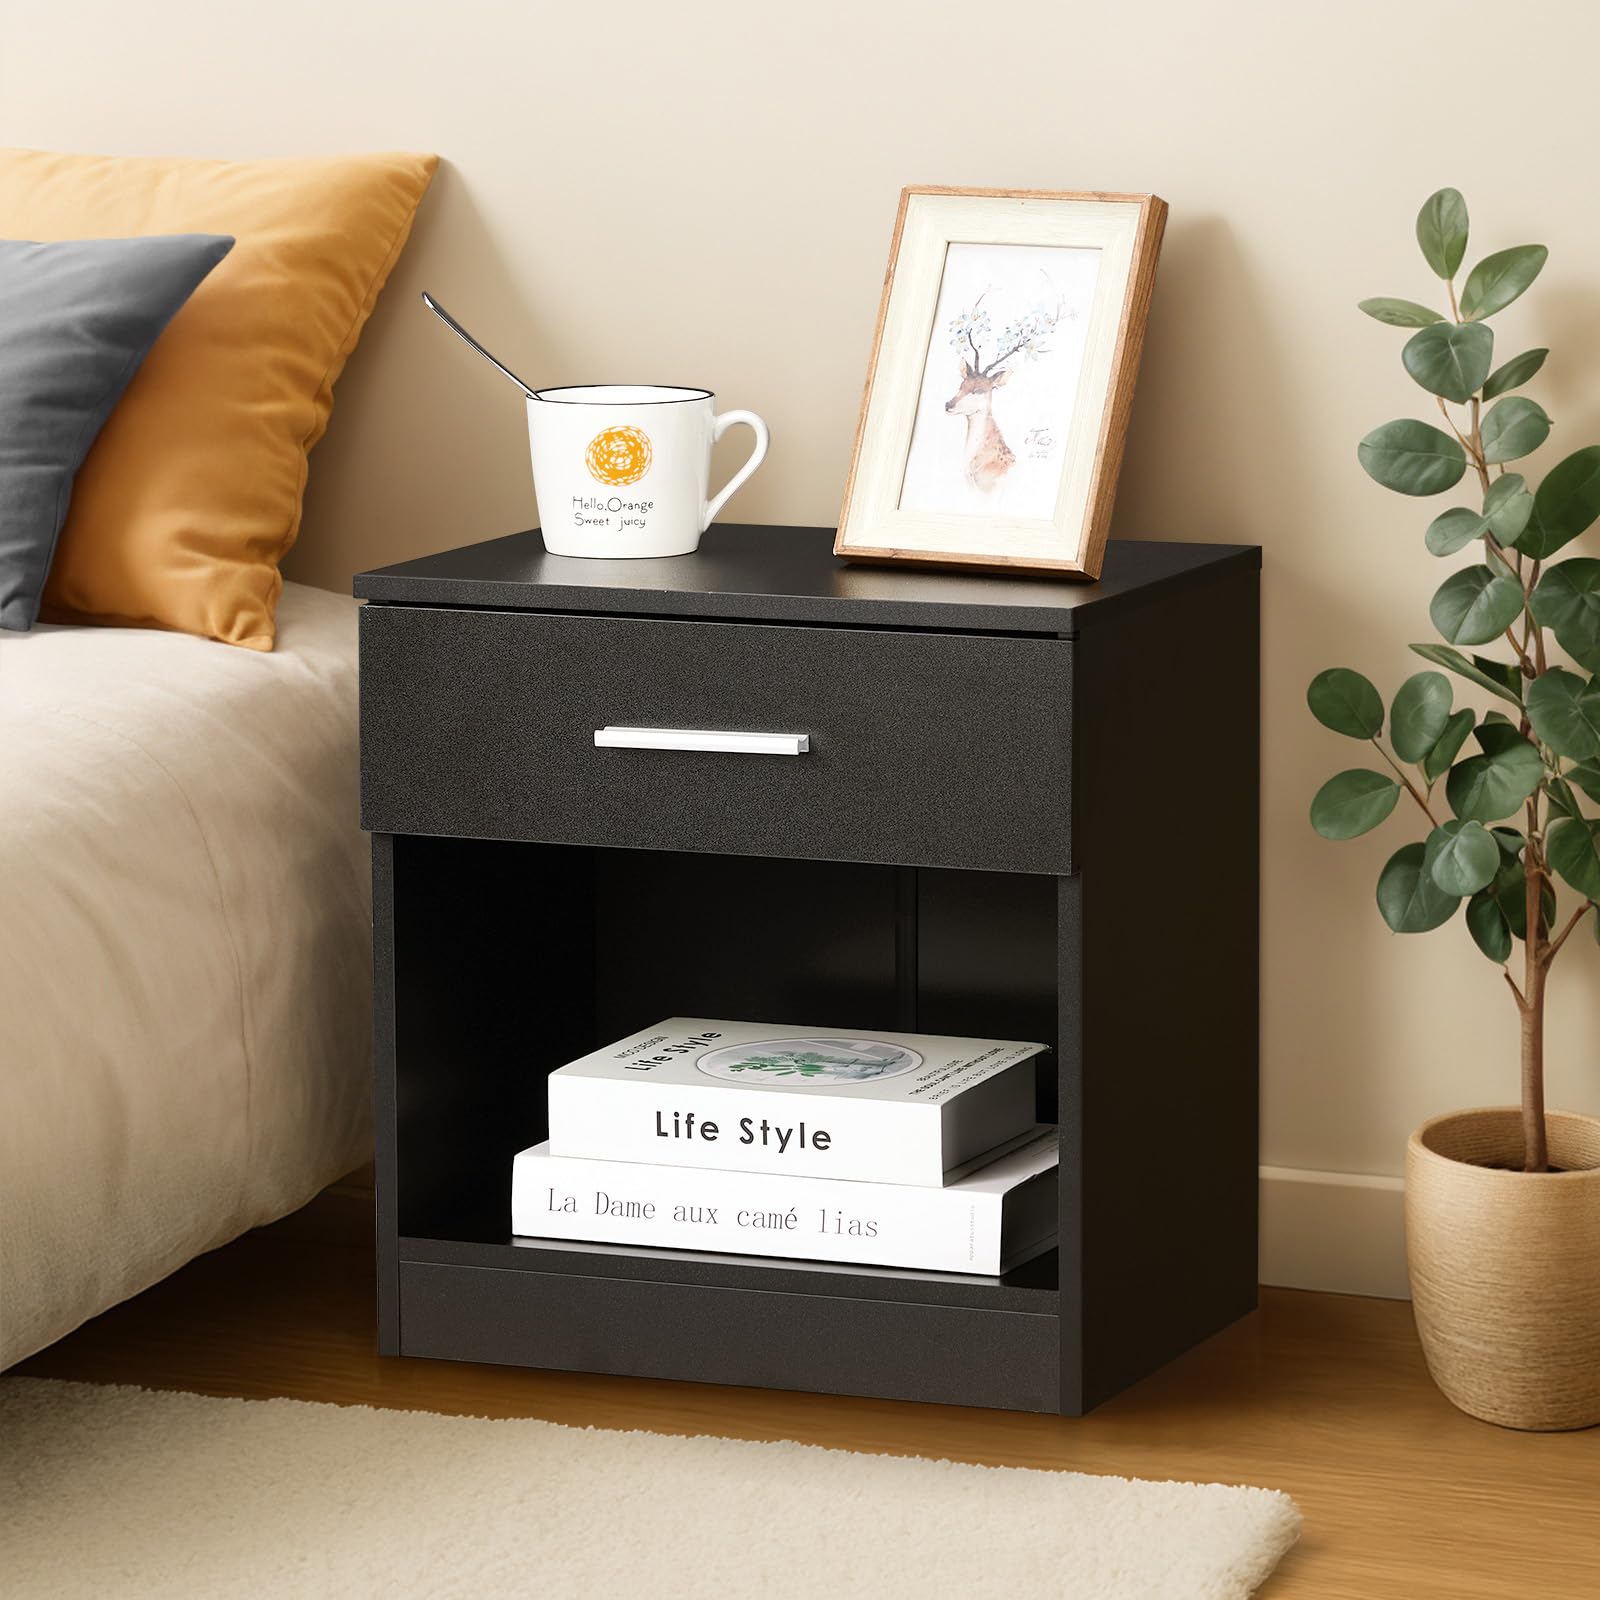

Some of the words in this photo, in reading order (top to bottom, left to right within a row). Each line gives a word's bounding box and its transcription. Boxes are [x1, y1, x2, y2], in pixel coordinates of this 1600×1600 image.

[574, 512, 610, 526] Sweet
[618, 516, 646, 531] juicy
[624, 1055, 673, 1071] Life
[662, 1032, 722, 1053] Style
[655, 1110, 720, 1142] Life
[738, 1117, 832, 1154] Style
[547, 1187, 578, 1213] La
[594, 1190, 657, 1220] Dame
[673, 1205, 719, 1225] aux
[736, 1207, 798, 1230] camé
[817, 1208, 879, 1238] lias
